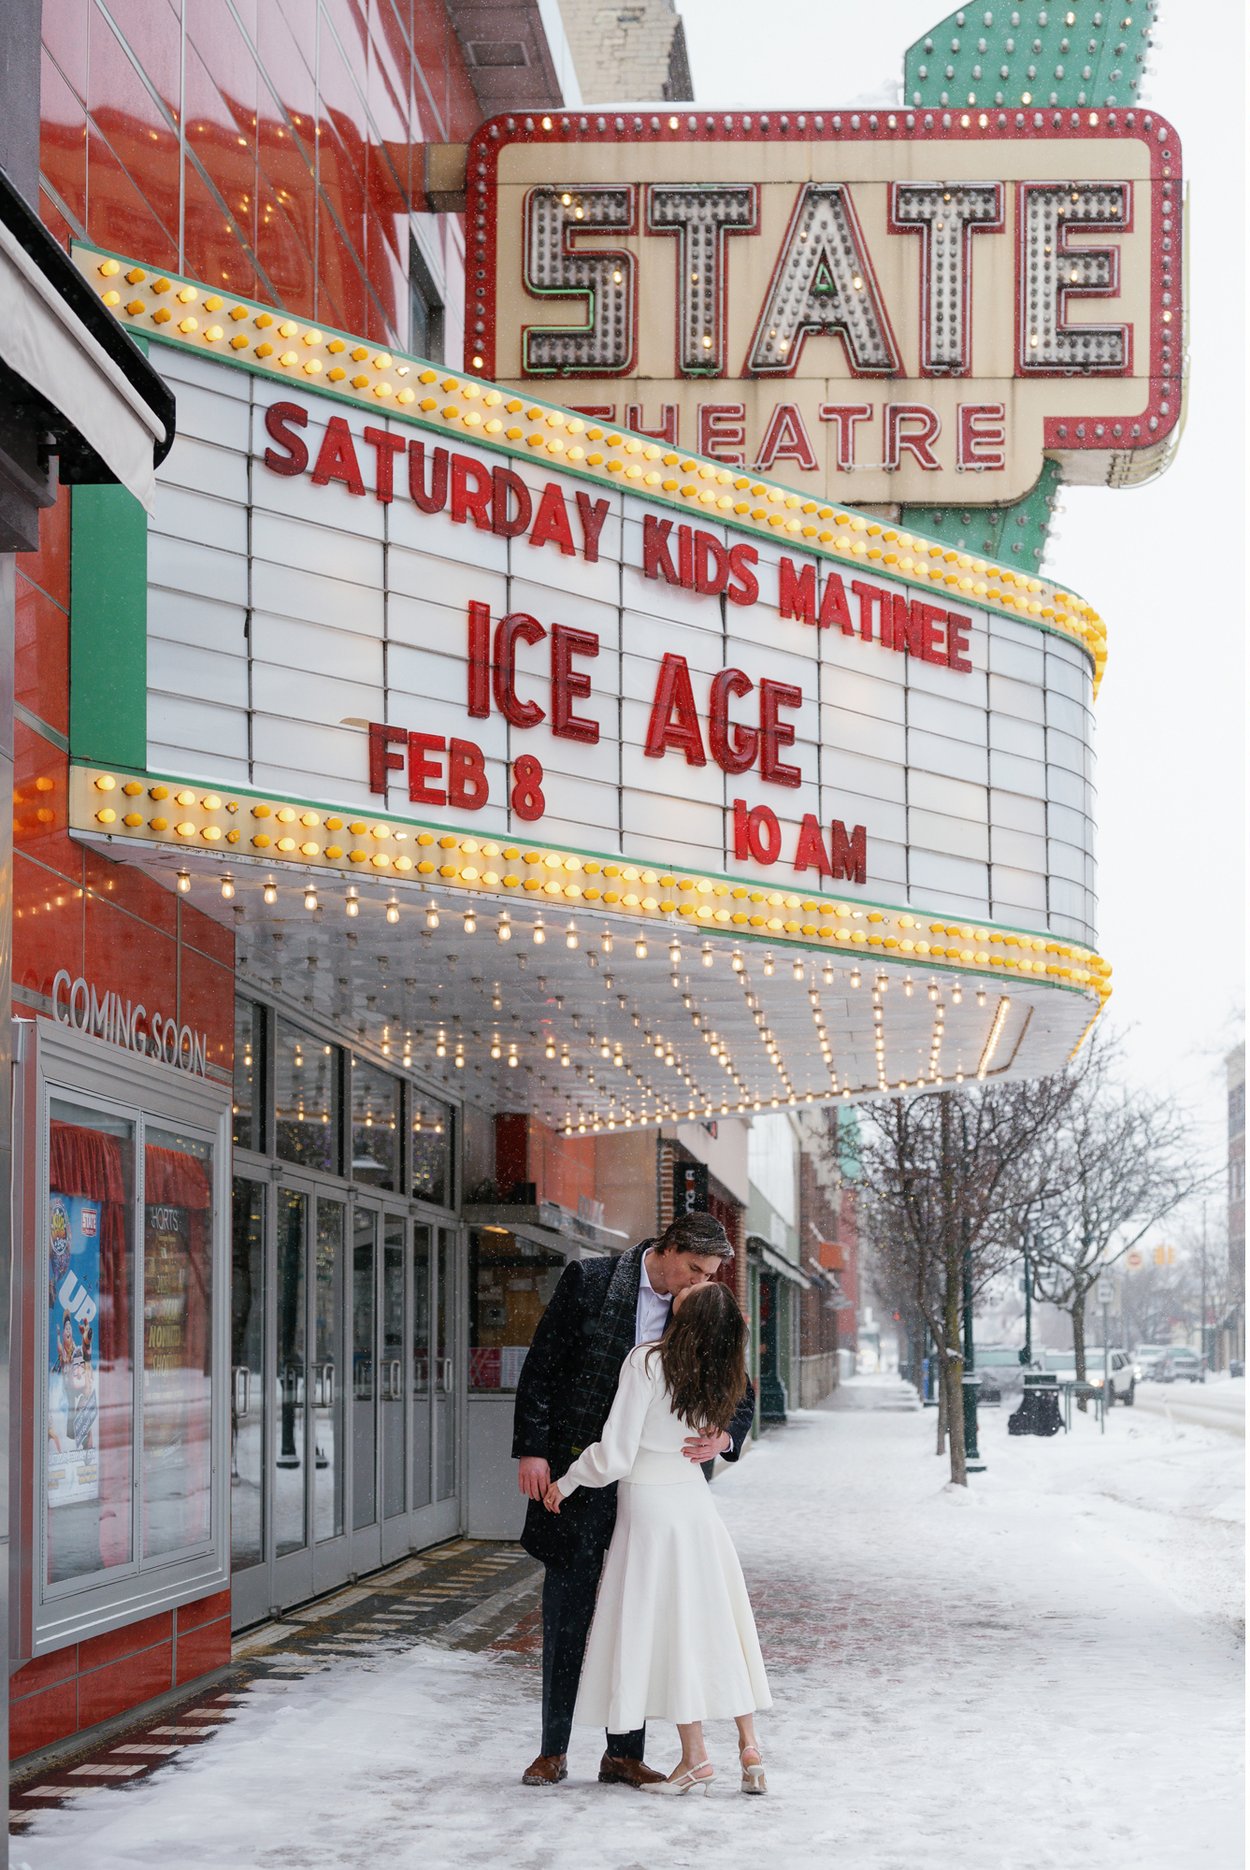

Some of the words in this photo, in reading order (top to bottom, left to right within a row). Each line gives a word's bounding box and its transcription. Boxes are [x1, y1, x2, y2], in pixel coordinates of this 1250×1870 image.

[520, 181, 1134, 379] STATE
[563, 402, 1007, 472] HEATRE
[264, 402, 611, 563] SATURDAY
[643, 513, 760, 606] KIDS
[778, 557, 973, 673] MATINEE
[467, 600, 600, 744] ICE
[644, 652, 803, 788] AGE
[368, 723, 490, 810] FEB
[511, 754, 546, 821] 8
[733, 798, 781, 865] 10
[794, 813, 867, 884] AM
[51, 968, 147, 1054] COMING
[151, 1011, 207, 1079] SOON
[58, 1269, 97, 1323] UP
